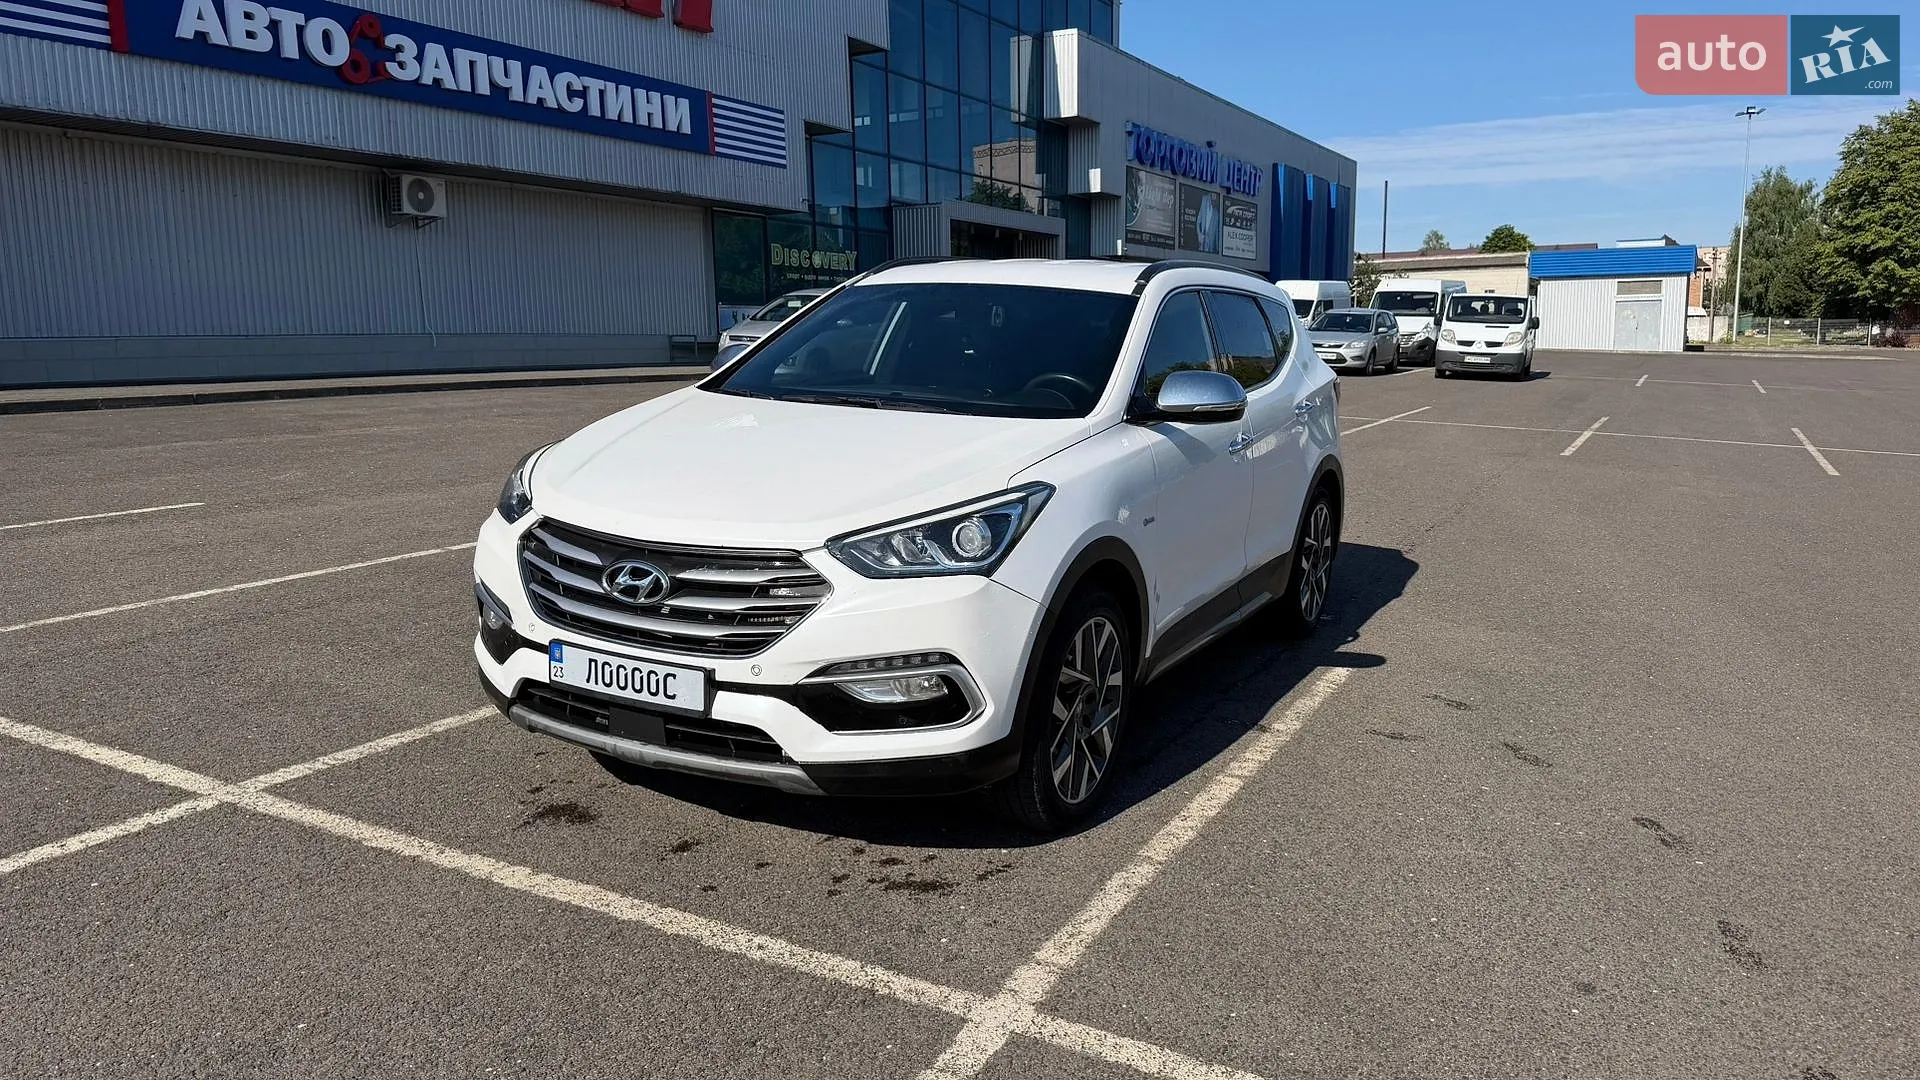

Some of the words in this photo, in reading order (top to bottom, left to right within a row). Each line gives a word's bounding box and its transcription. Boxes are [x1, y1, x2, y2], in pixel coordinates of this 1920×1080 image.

[175, 0, 350, 67] АВТО
[384, 33, 691, 134] ЗАПЧАСТИНИ
[1125, 121, 1218, 184] ТОРГОВИЙ
[1219, 154, 1264, 197] ЦЕНТР
[553, 665, 564, 678] 23
